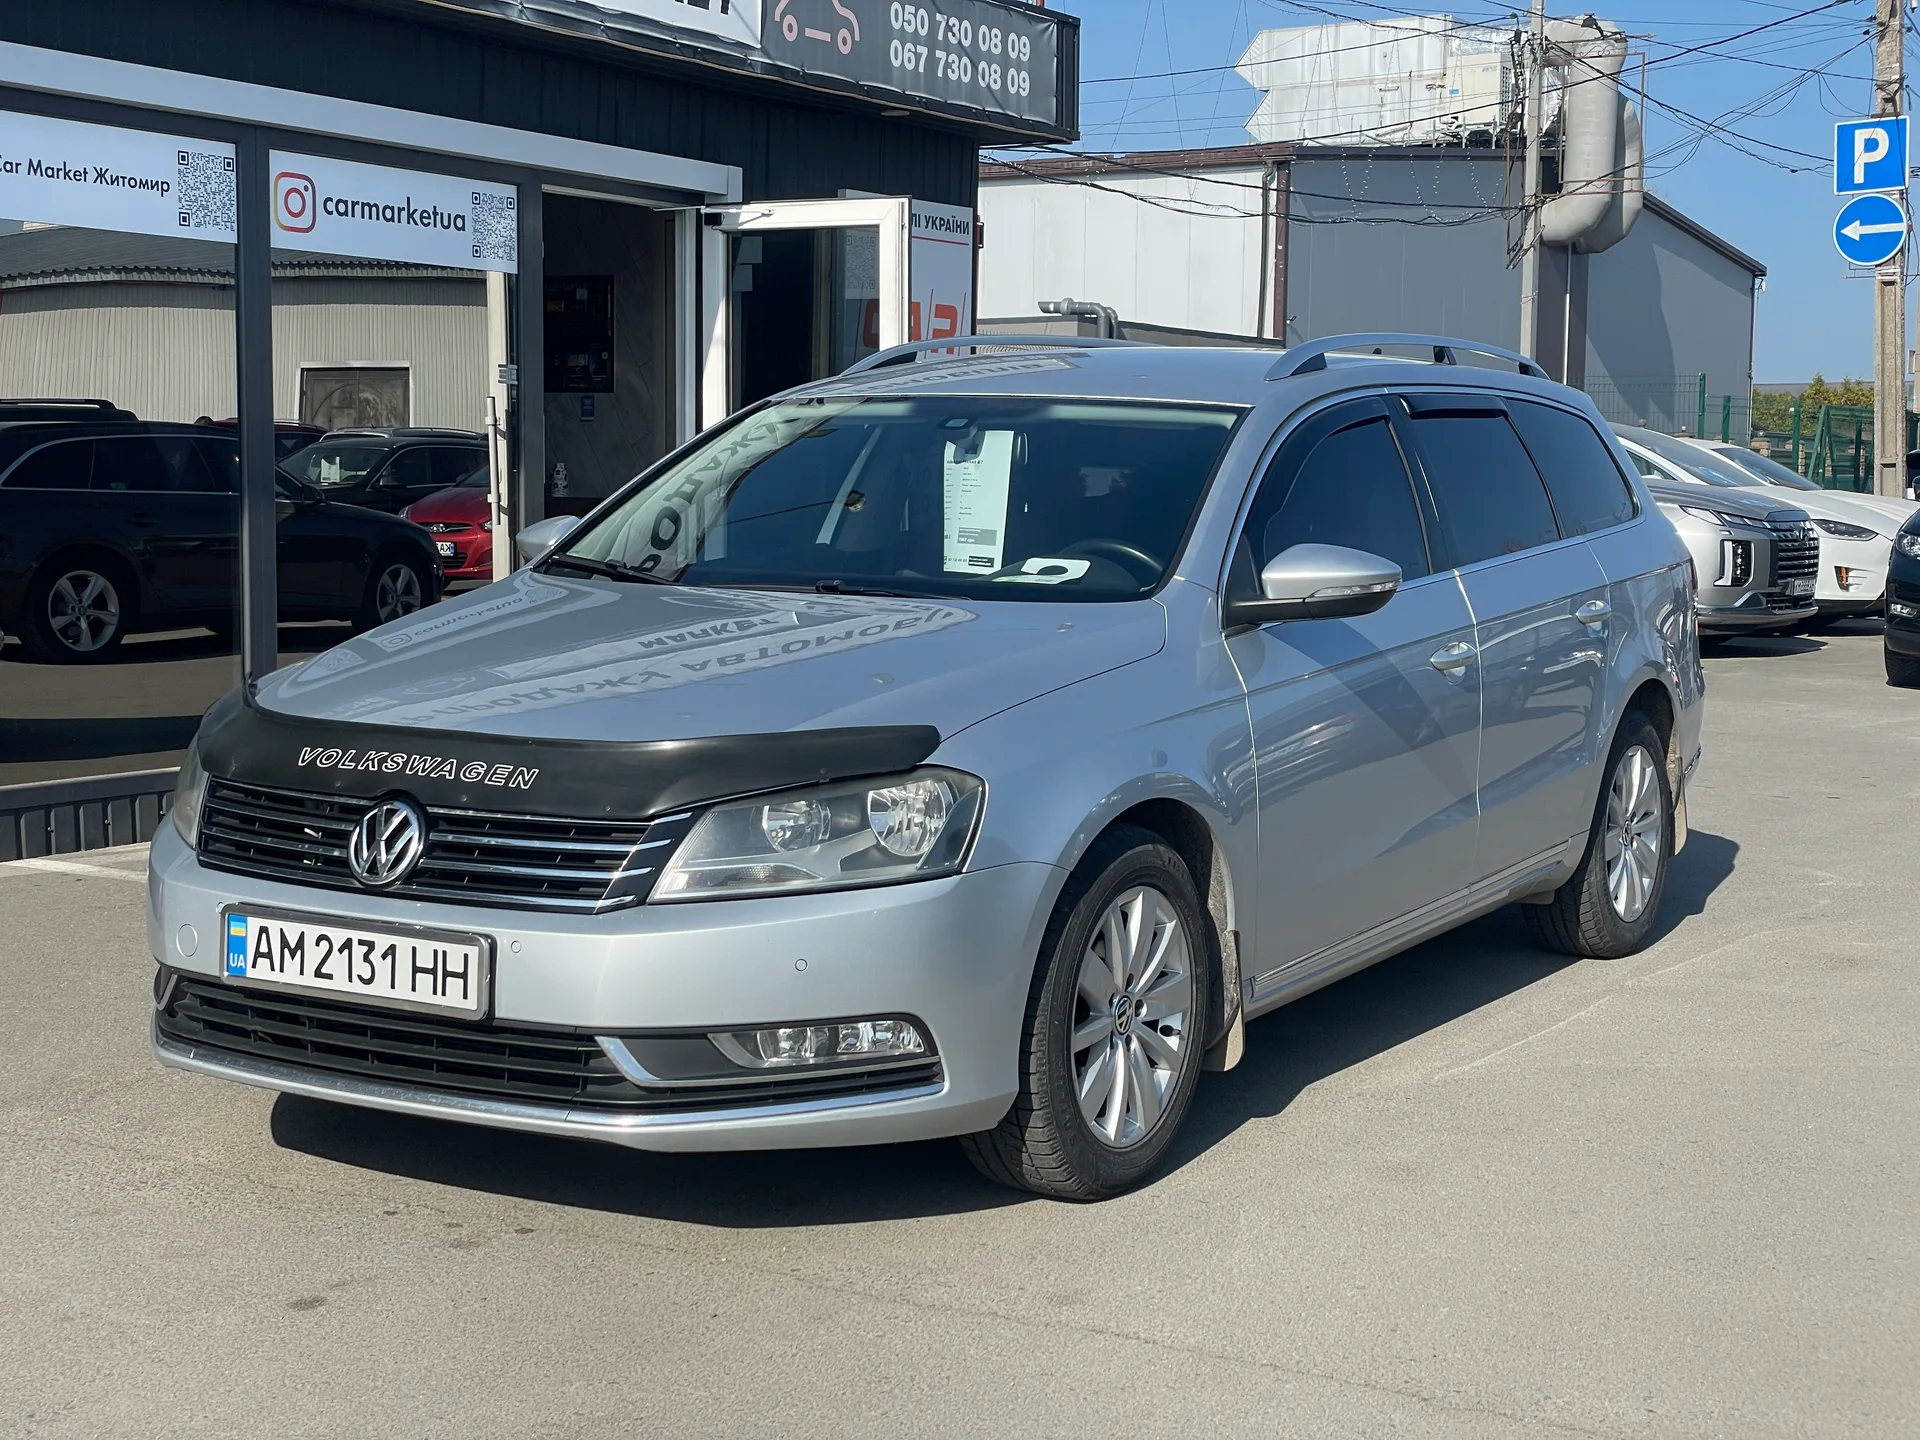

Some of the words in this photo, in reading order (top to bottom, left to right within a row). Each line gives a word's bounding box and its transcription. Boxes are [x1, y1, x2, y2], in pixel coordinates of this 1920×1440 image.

[890, 1, 929, 36] 050
[936, 13, 972, 47] 730
[978, 25, 1002, 55] 08
[1007, 32, 1031, 62] 09
[890, 39, 928, 72] 067
[936, 50, 972, 83] 730
[978, 61, 1001, 90] 08
[1007, 68, 1030, 97] 09
[1853, 127, 1890, 185] P
[27, 158, 89, 183] Market
[93, 166, 171, 197] Житомир
[322, 196, 466, 232] carmarketua
[924, 214, 970, 236] УКРАЇНИ
[297, 747, 539, 789] VOLKSWAGEN
[230, 952, 246, 969] UA
[251, 925, 306, 977] AM
[314, 933, 397, 991] 2131
[411, 945, 469, 1000] HH
